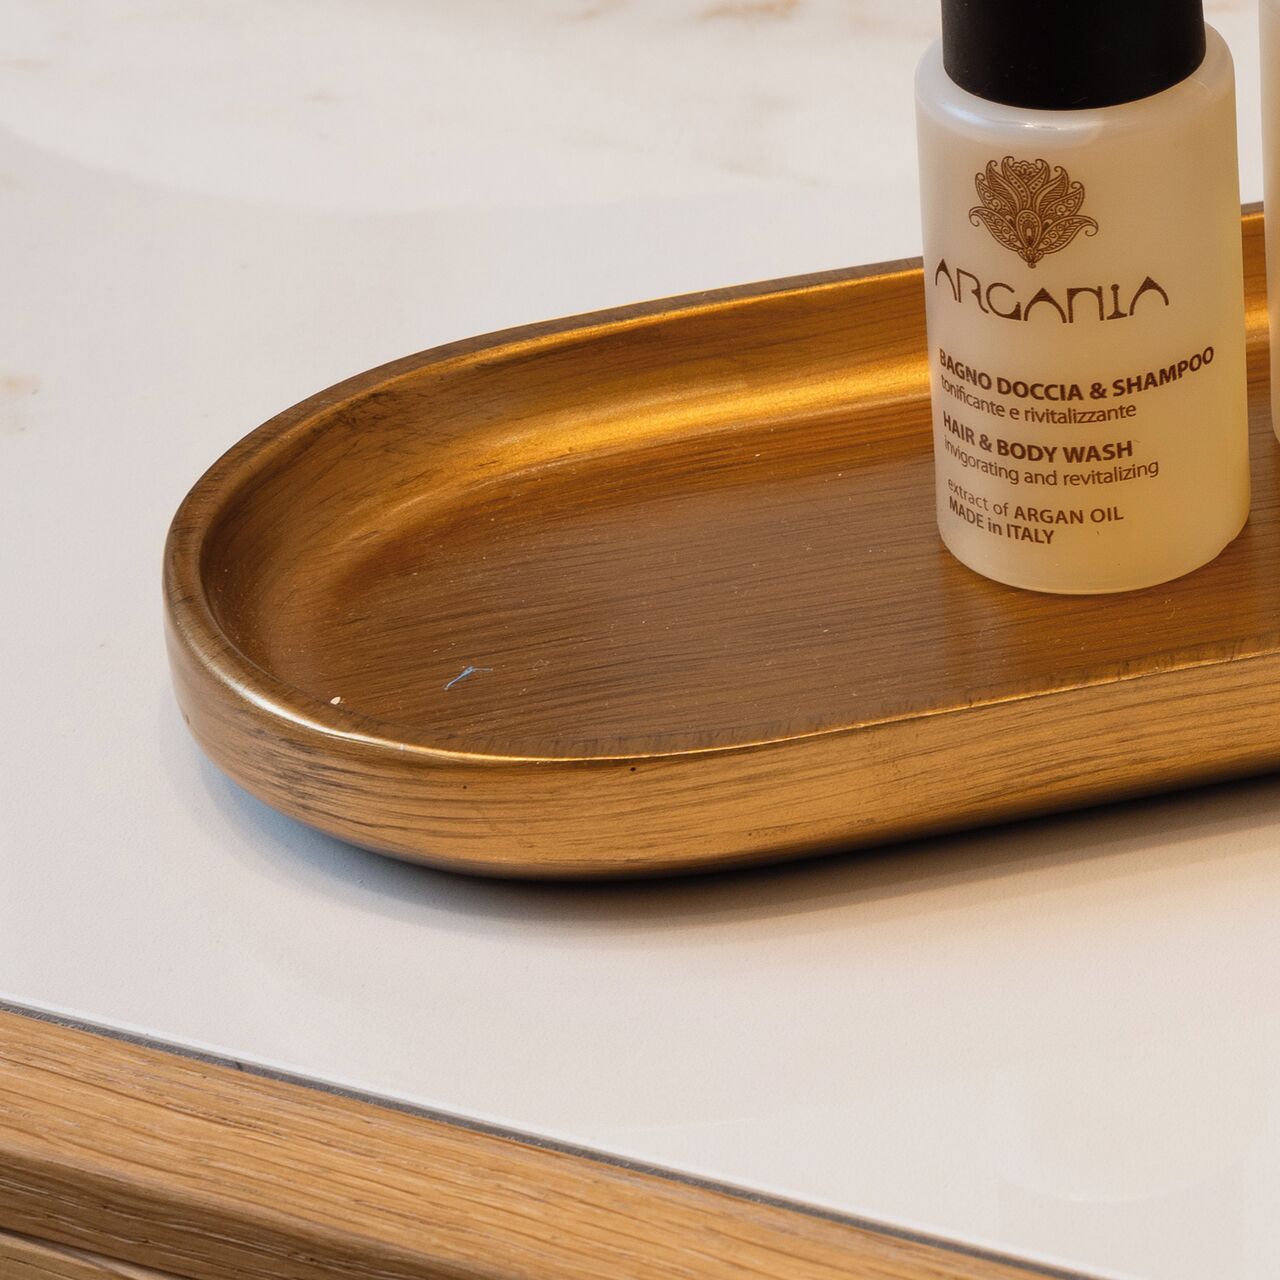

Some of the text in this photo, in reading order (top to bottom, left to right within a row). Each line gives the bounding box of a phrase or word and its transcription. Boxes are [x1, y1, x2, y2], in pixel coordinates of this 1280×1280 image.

[934, 258, 1170, 324] ARGANIA
[938, 345, 1215, 402] BAGNO DOCCIA & SHAMPOO
[940, 374, 1137, 425] tonificante e rivitalizzante
[942, 410, 1134, 464] HAIR & BODY WASH
[943, 435, 1160, 486] invigorating and revitalizing
[946, 478, 1125, 525] extract of ARGAN OIL
[948, 495, 1055, 545] MADE in ITALY
